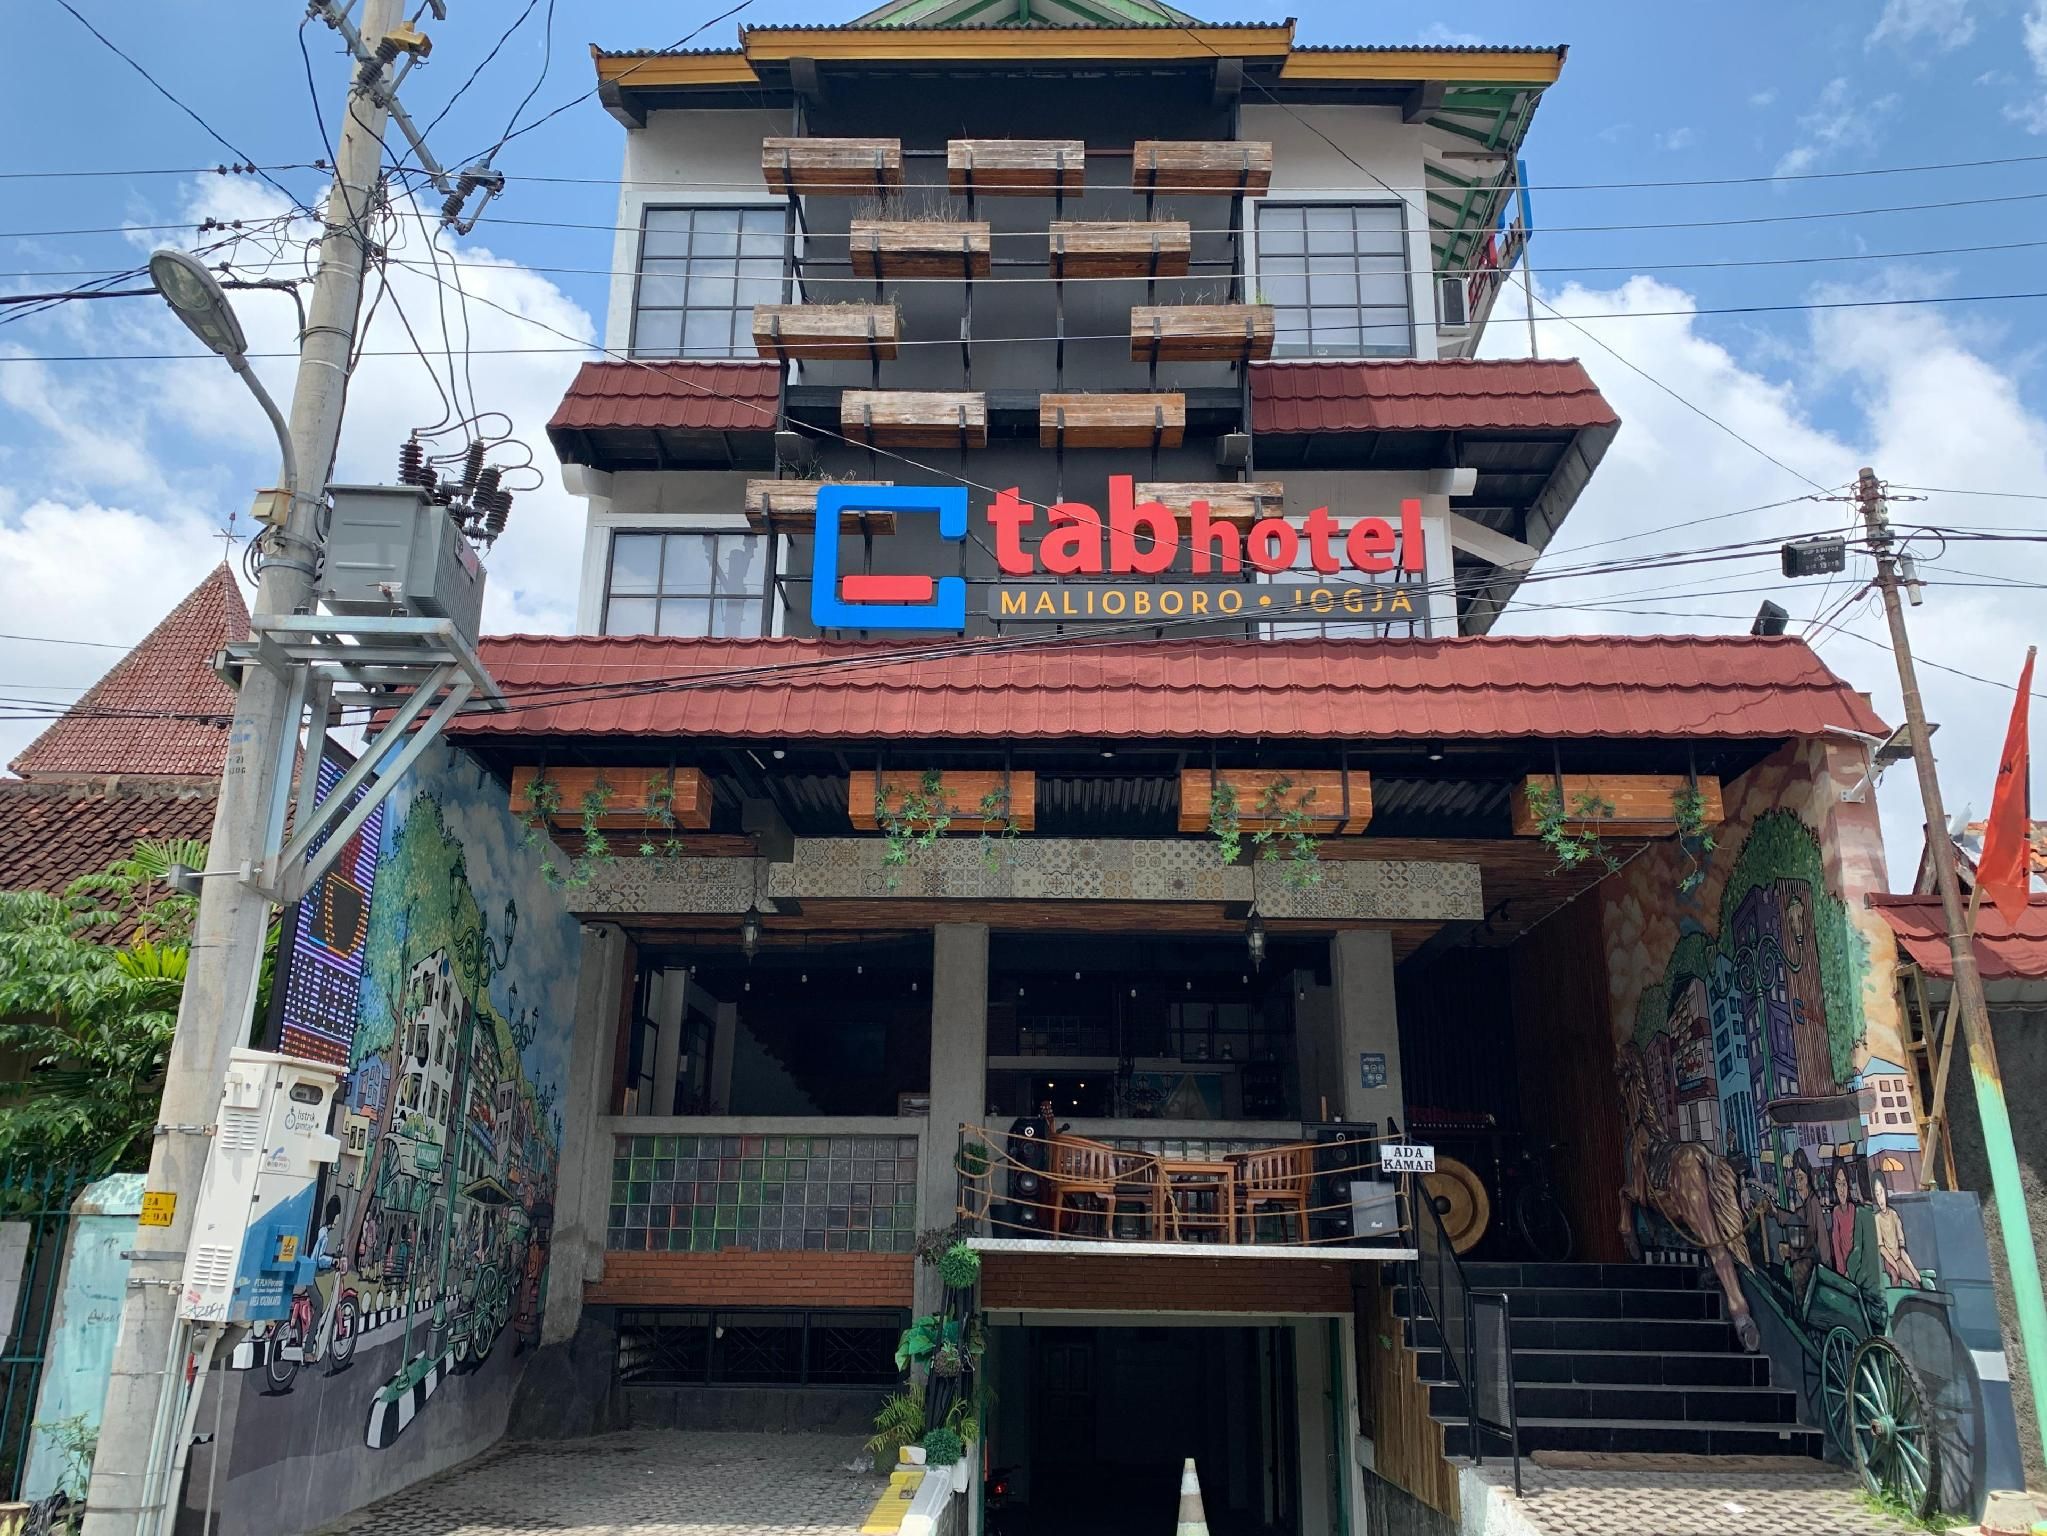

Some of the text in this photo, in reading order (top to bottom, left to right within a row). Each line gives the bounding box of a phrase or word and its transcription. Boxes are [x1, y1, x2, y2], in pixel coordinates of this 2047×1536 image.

[1000, 588, 1414, 615] MALIOBORO JOGJA
[1393, 1147, 1424, 1158] ADA
[1383, 1158, 1434, 1171] KAMAR
